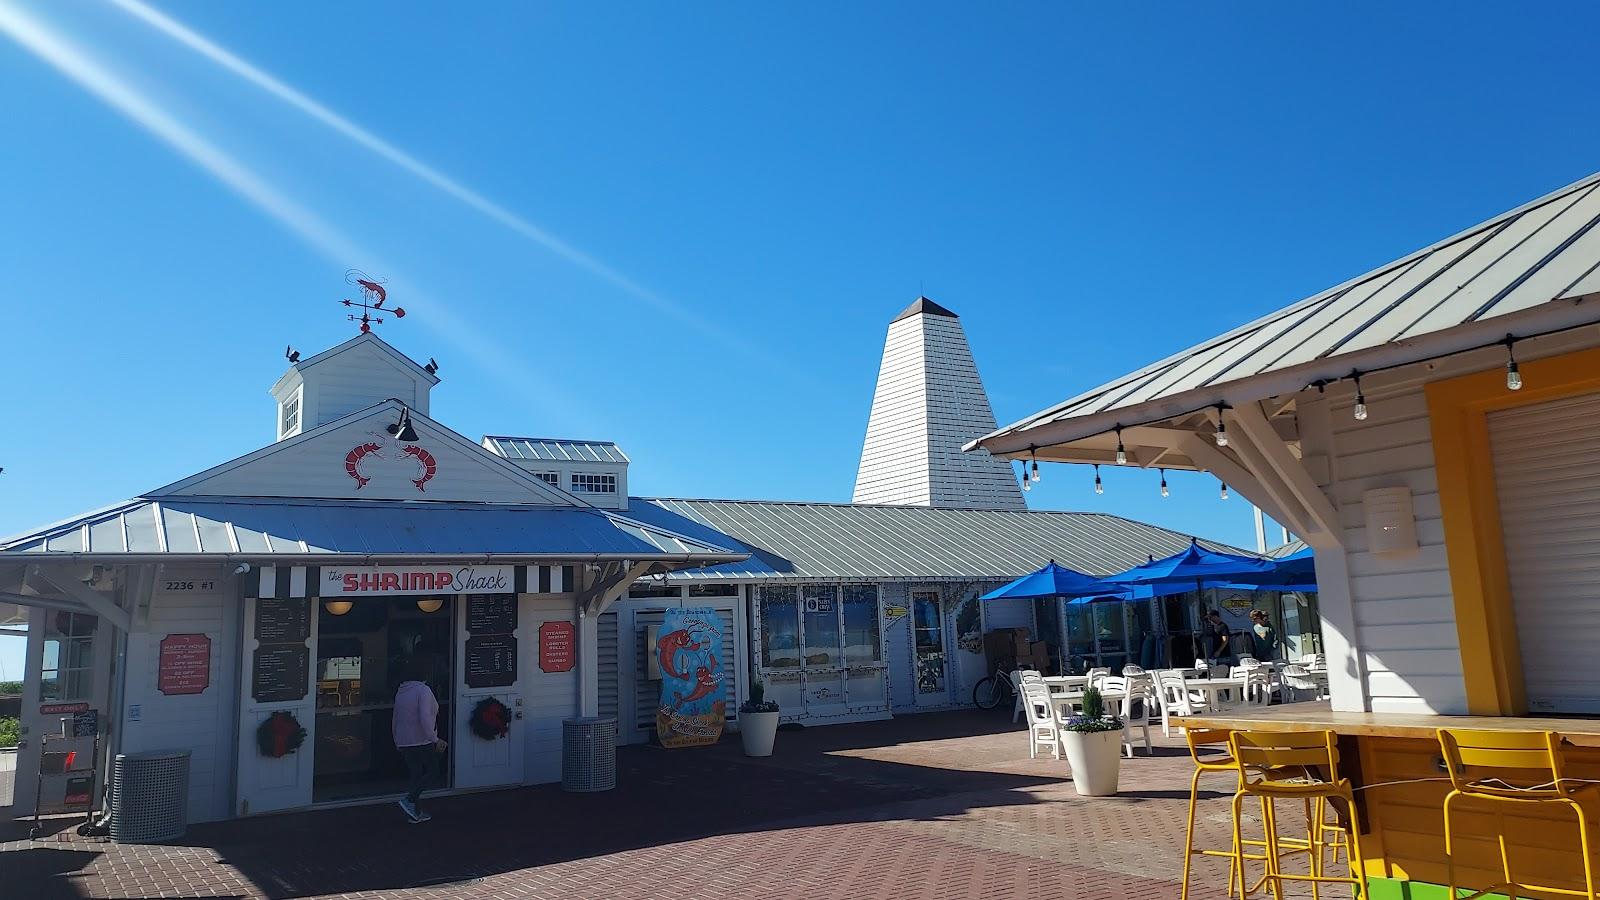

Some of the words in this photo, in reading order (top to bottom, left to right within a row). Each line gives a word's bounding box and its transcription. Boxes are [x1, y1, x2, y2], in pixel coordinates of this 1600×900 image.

[166, 581, 194, 590] 2236
[200, 581, 214, 590] #1
[328, 570, 342, 582] the
[342, 571, 453, 592] SHRIMP
[451, 567, 507, 592] Shack
